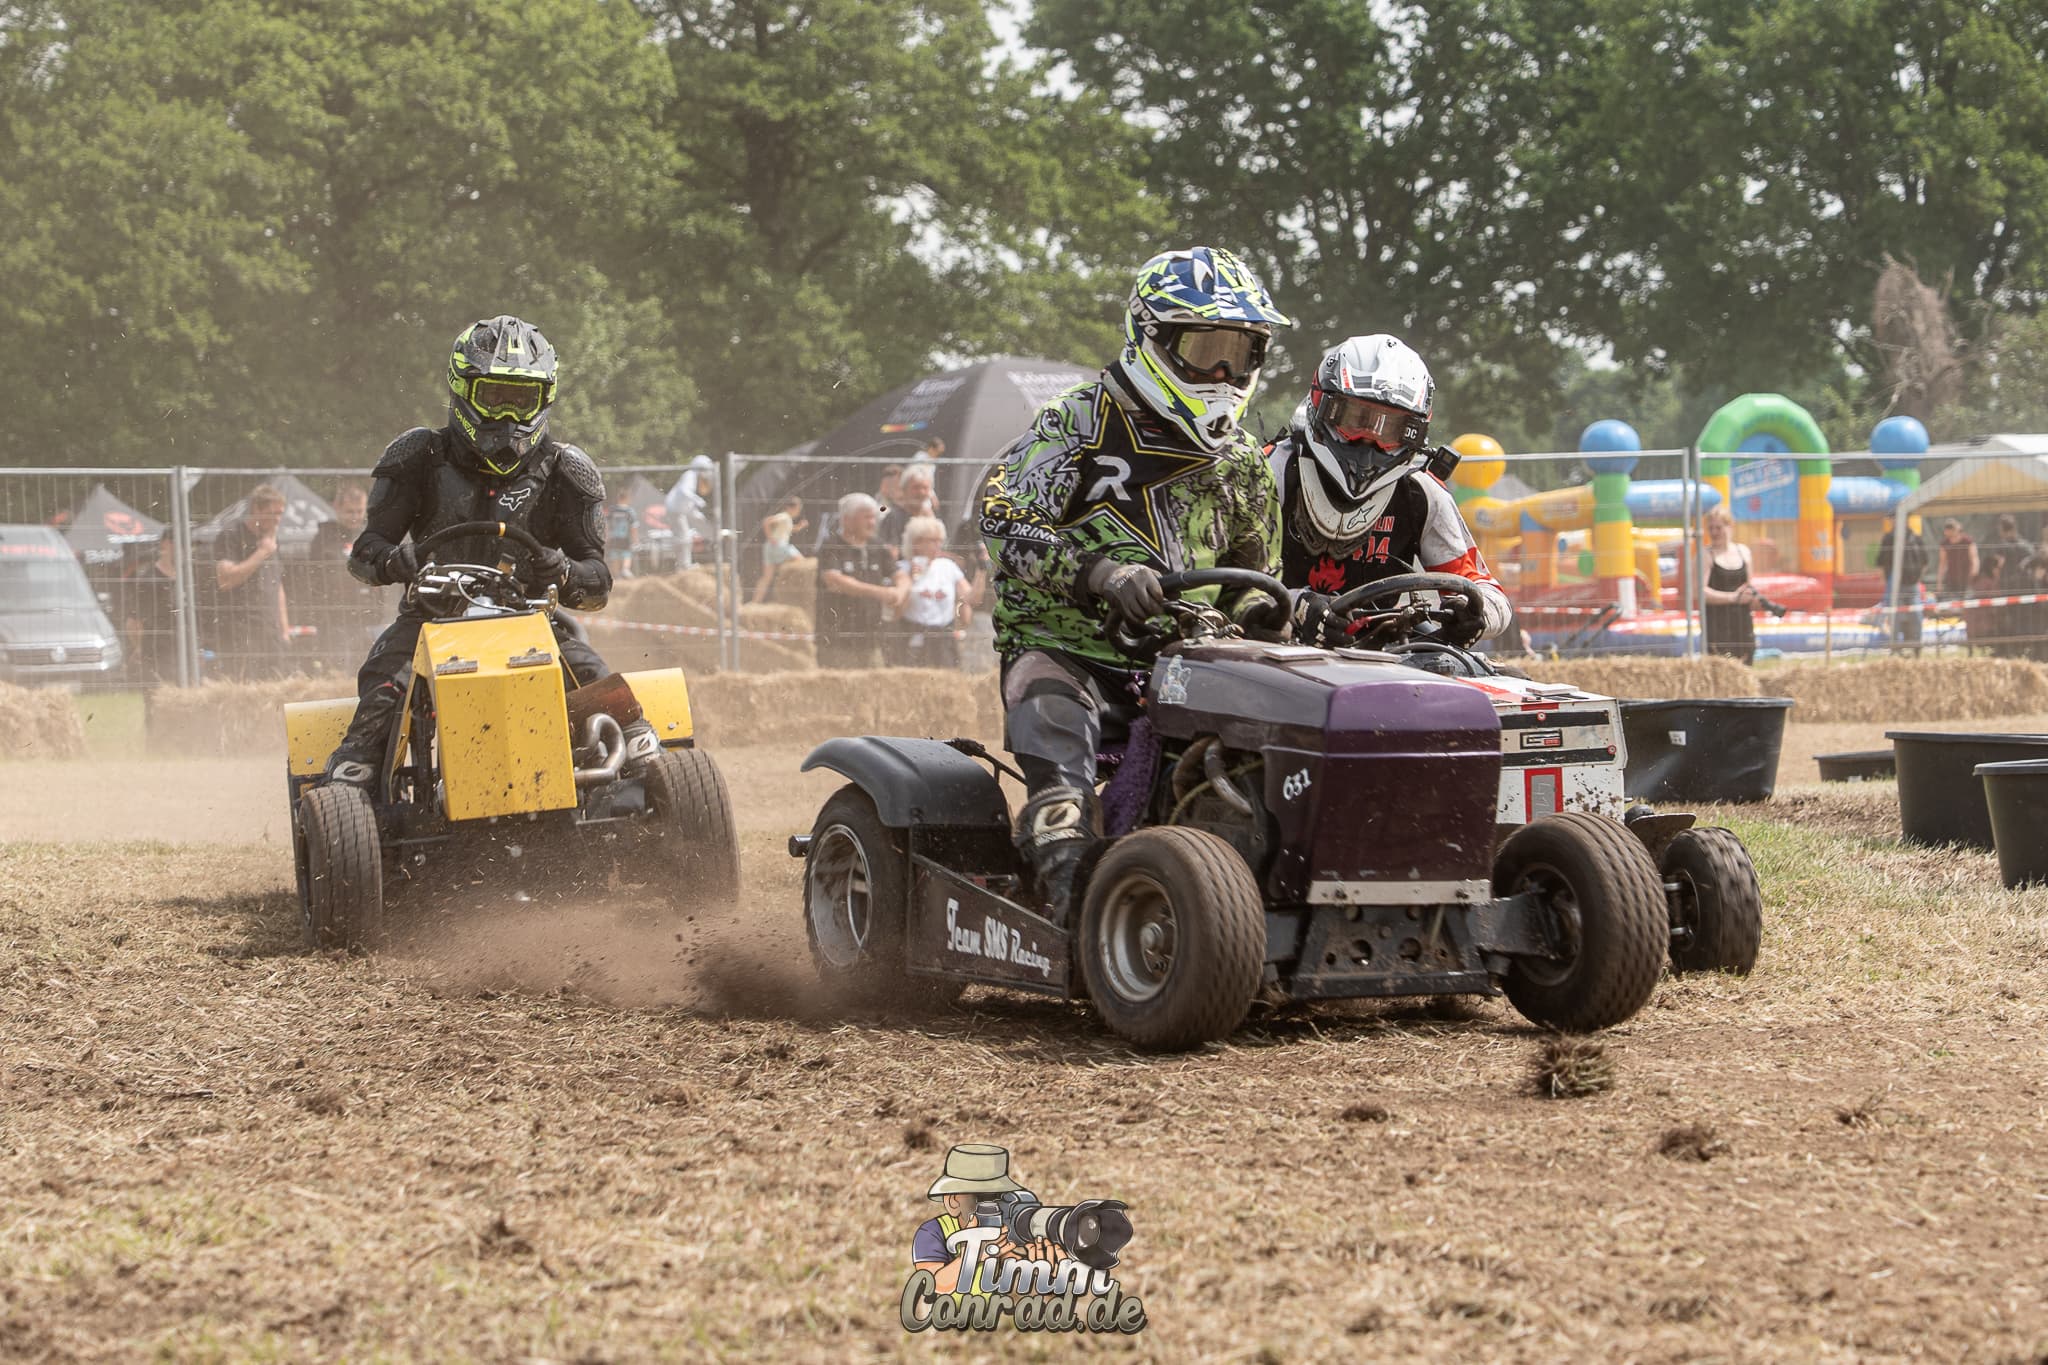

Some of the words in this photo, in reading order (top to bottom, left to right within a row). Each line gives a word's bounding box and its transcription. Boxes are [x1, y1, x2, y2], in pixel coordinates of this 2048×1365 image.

[1086, 455, 1132, 501] R
[1283, 768, 1312, 800] 631
[946, 897, 982, 956] Team
[1010, 927, 1051, 978] Racing
